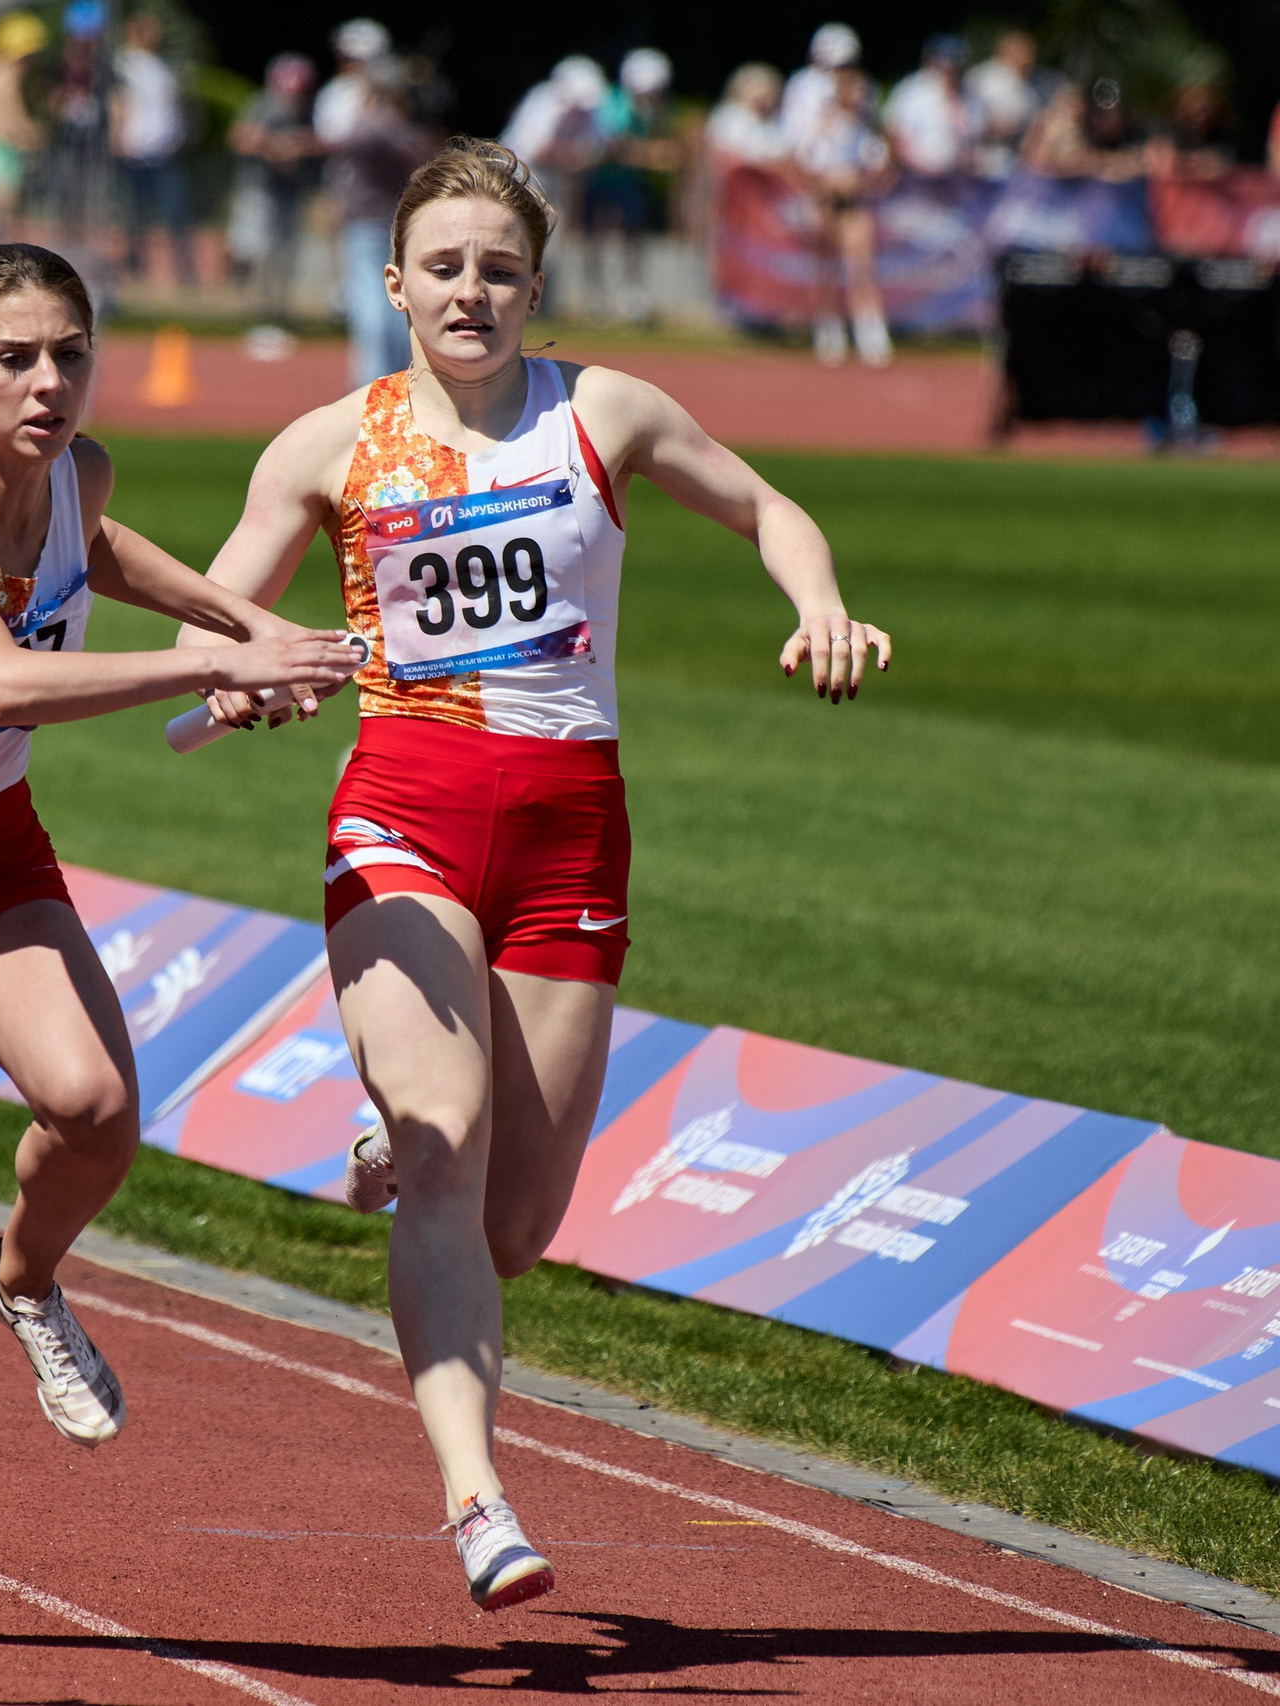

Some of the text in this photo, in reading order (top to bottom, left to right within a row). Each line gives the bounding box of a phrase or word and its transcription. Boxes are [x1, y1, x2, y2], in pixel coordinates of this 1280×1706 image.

[458, 495, 552, 519] ЗАРУБЕЖНЕФТЬ
[409, 537, 548, 636] 399
[403, 648, 542, 674] КОМАНДНЫЙ ЧЕМПИОНАТ РОССИИ
[427, 671, 447, 679] 2024
